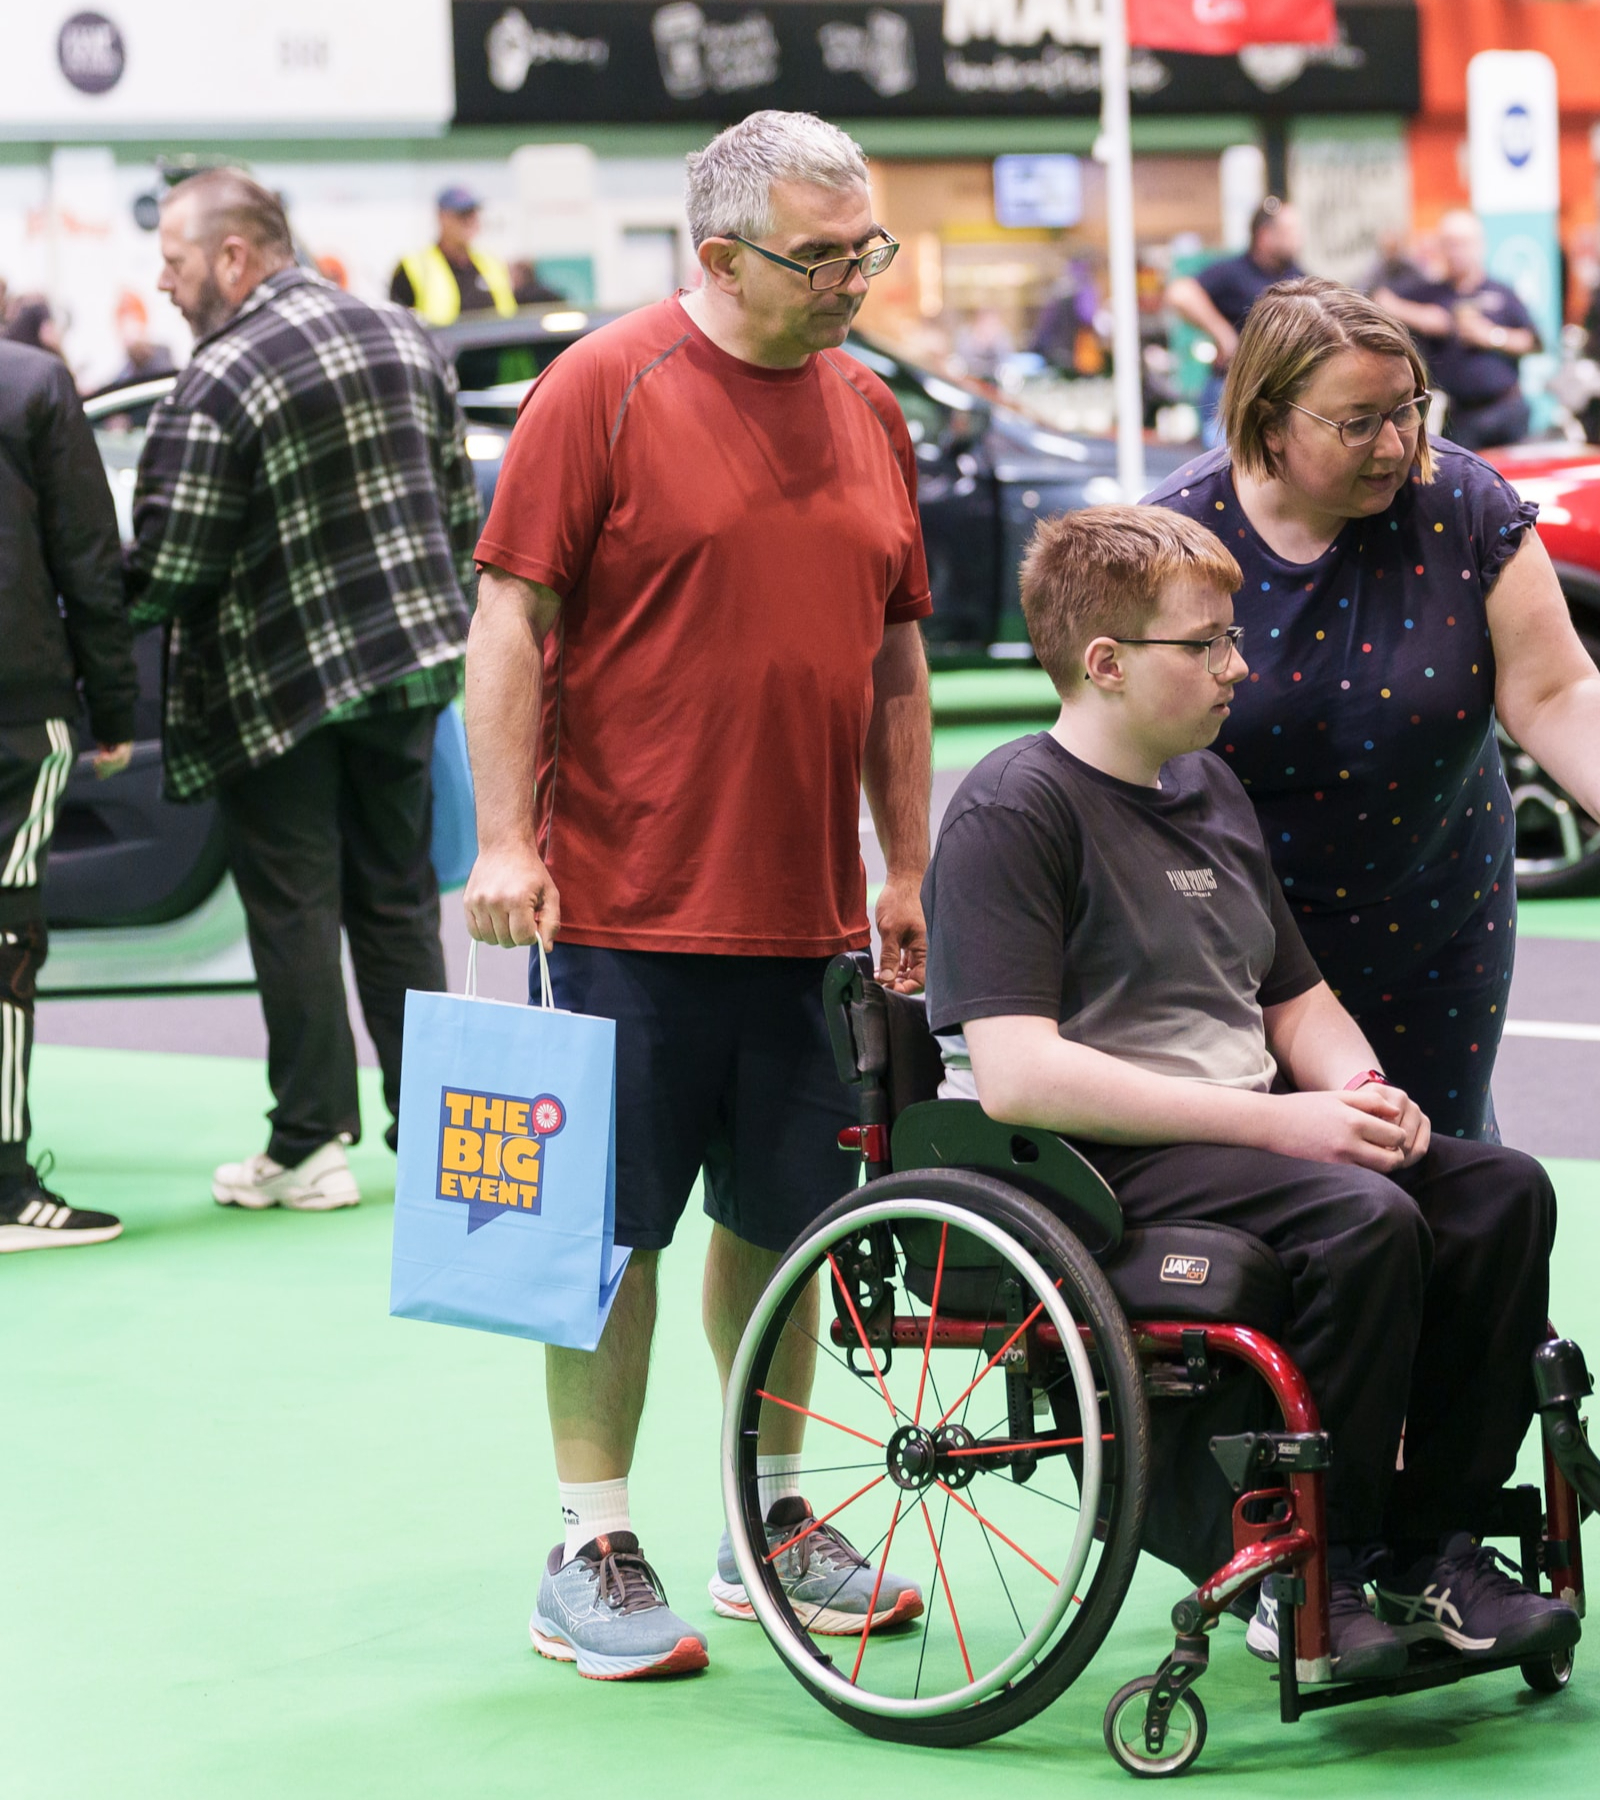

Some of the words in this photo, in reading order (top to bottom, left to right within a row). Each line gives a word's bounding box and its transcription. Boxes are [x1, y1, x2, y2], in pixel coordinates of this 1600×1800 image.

[445, 1092, 530, 1136] THE
[442, 1127, 541, 1182] BIG
[440, 1171, 538, 1209] EVENT
[1164, 1258, 1192, 1274] JAY
